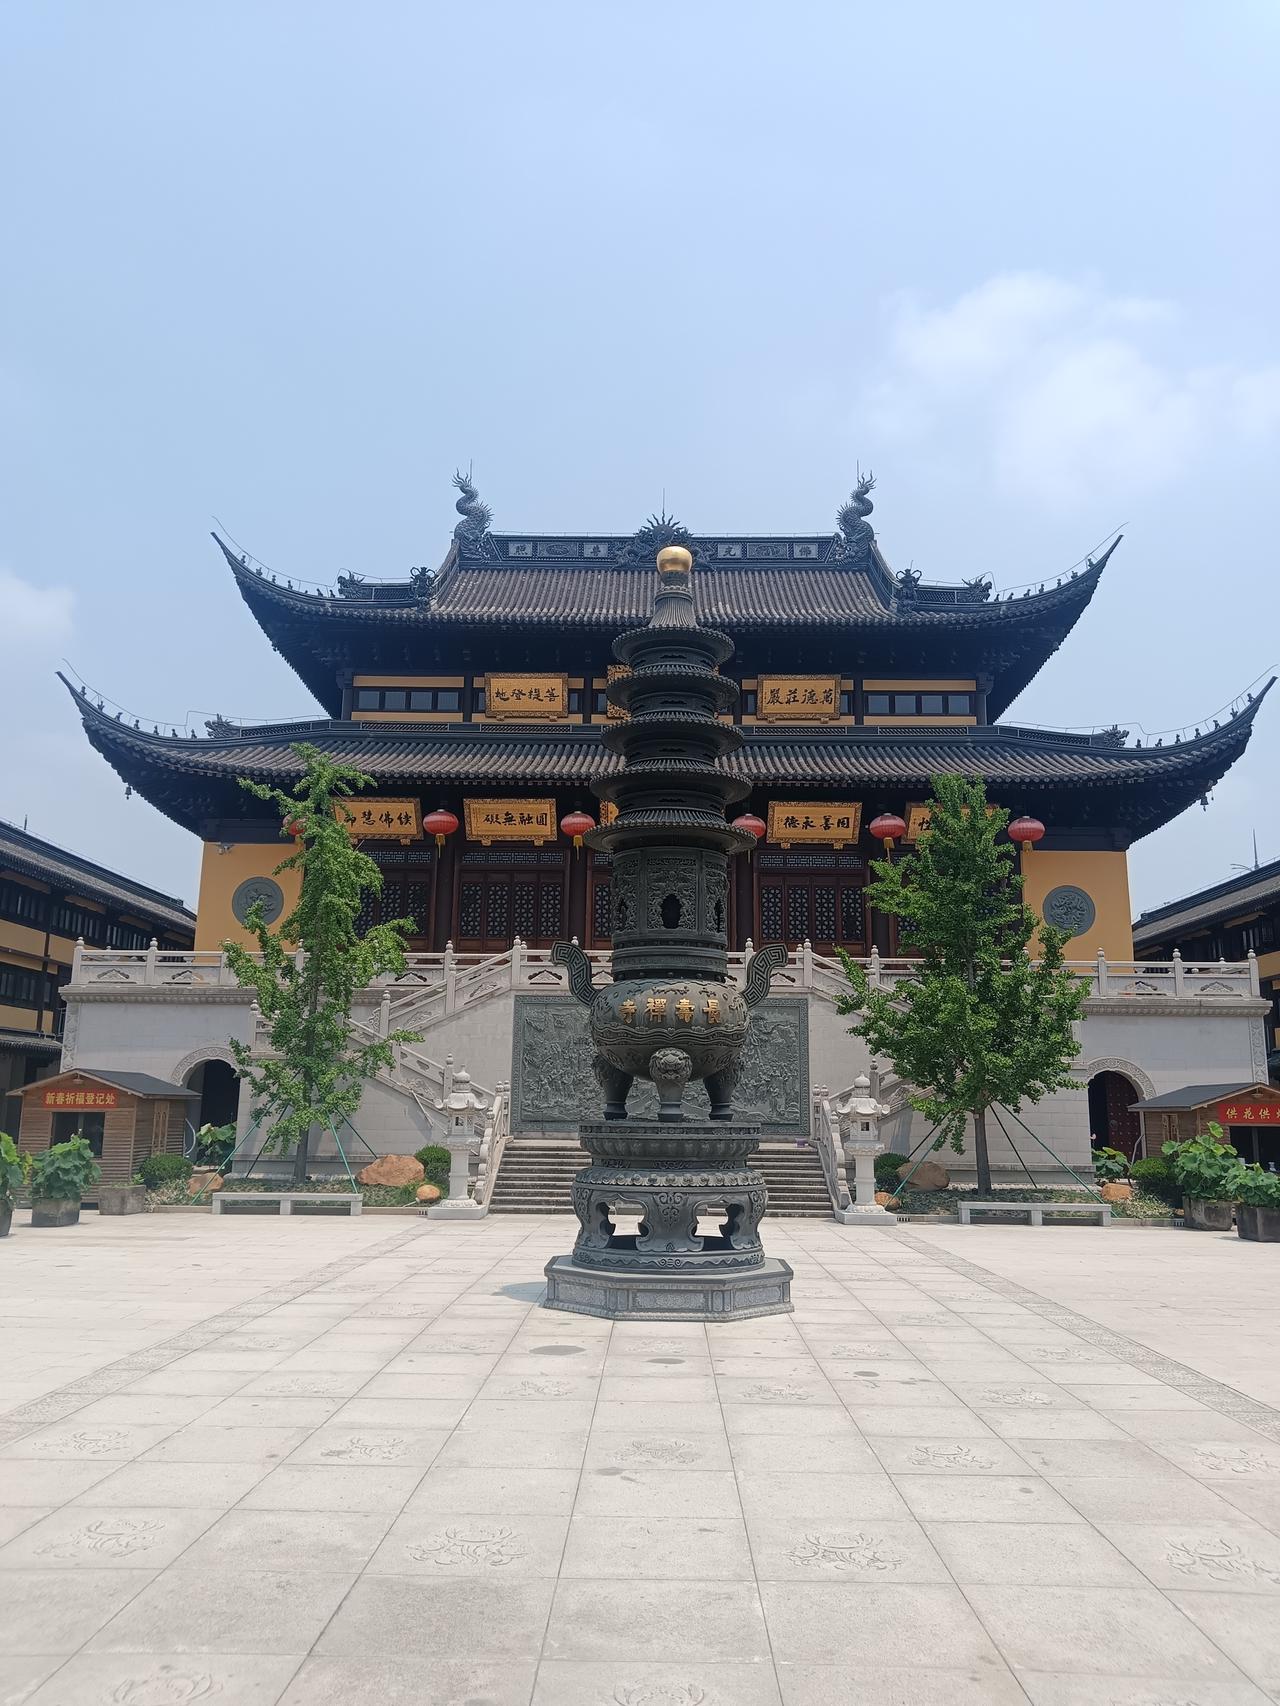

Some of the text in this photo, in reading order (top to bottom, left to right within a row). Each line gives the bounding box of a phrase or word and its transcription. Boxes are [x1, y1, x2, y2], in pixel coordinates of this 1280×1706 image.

[45, 1092, 116, 1105] 新春祈福登记处
